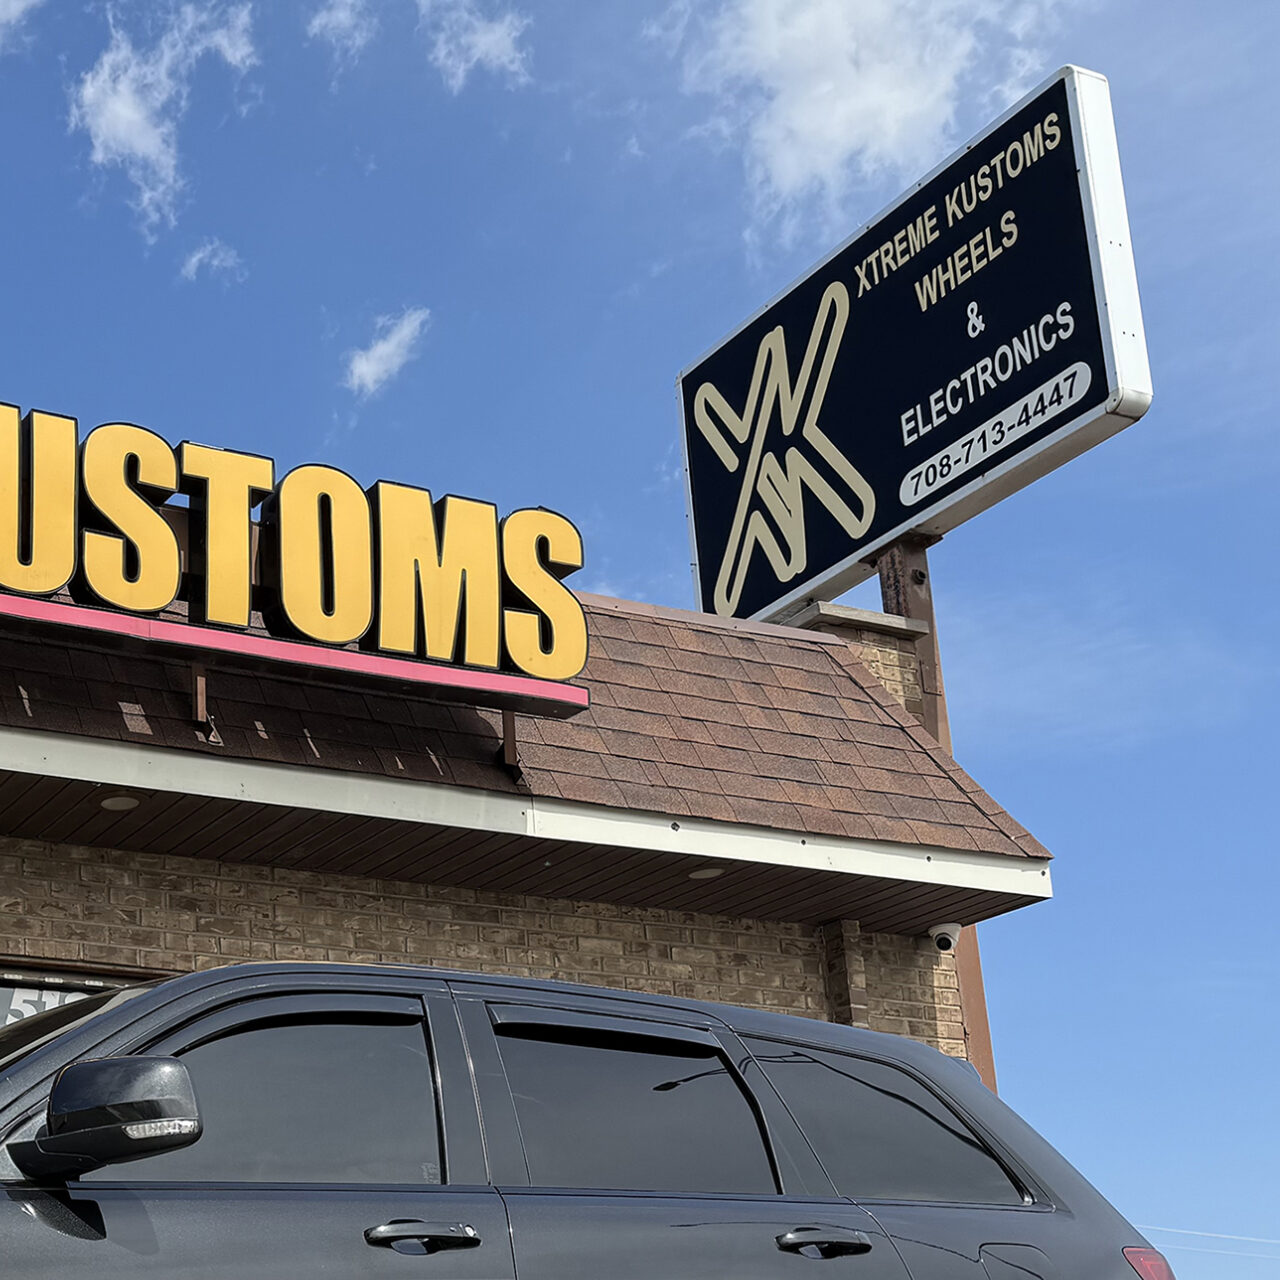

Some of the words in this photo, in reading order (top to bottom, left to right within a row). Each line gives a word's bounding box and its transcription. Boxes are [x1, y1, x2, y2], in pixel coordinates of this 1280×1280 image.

[854, 205, 940, 298] XTREME
[945, 112, 1062, 228] KUSTOMS
[914, 210, 1019, 312] WHEELS
[900, 301, 1075, 447] ELECTRONICS
[967, 301, 985, 338] &
[910, 370, 1078, 497] 708-713-4447
[5, 987, 93, 1025] 51
